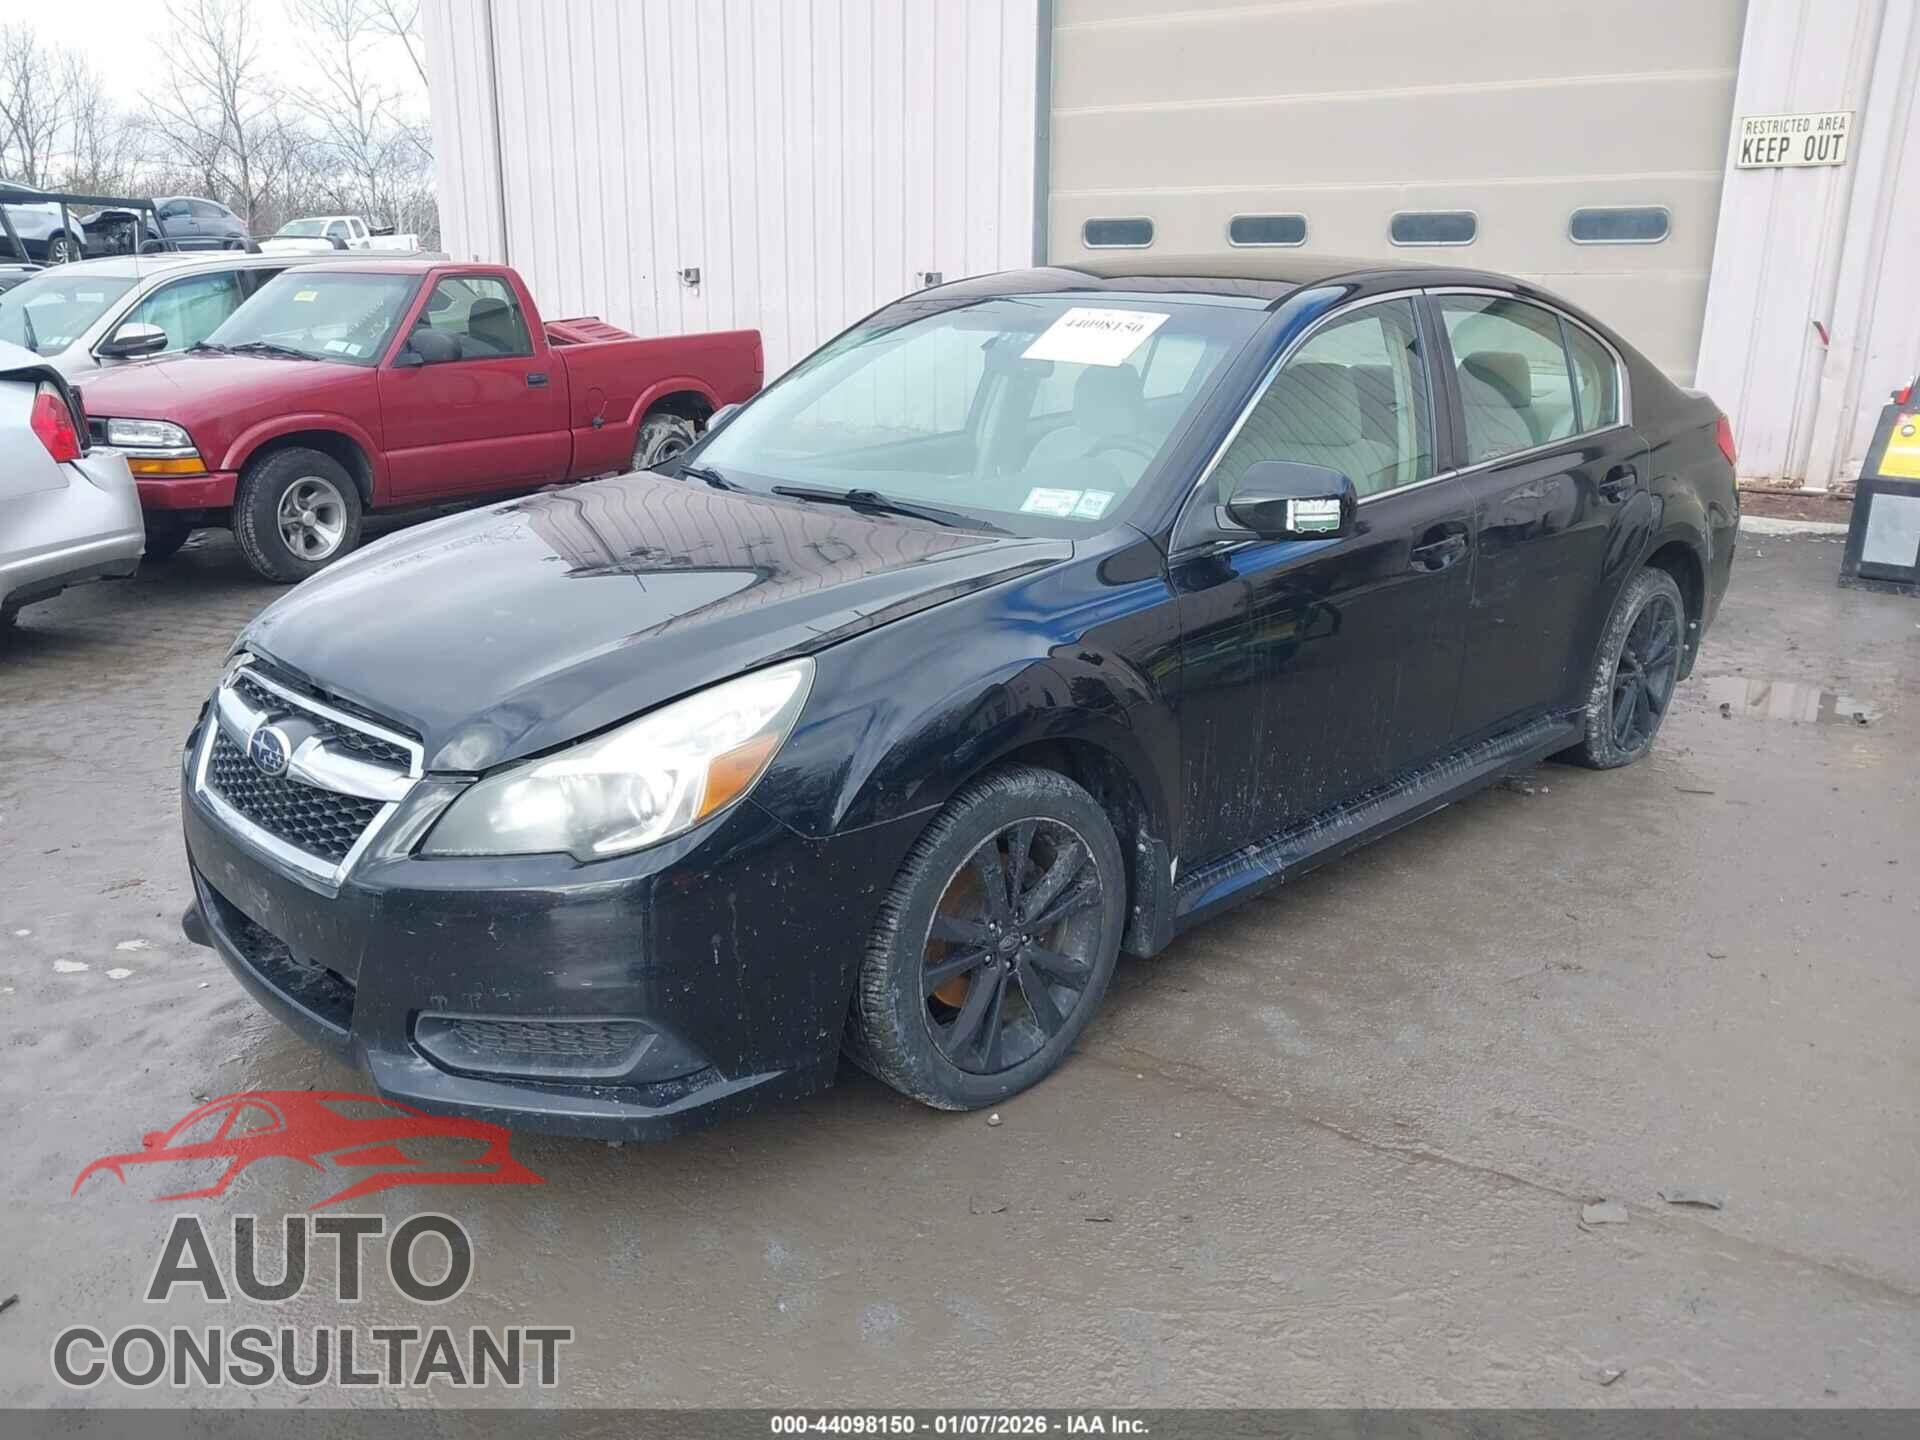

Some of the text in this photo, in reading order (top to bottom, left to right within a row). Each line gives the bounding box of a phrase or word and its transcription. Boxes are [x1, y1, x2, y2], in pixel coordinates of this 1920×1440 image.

[1745, 116, 1846, 135] RESTRICTED AREA
[1741, 133, 1844, 163] KEEP OUT
